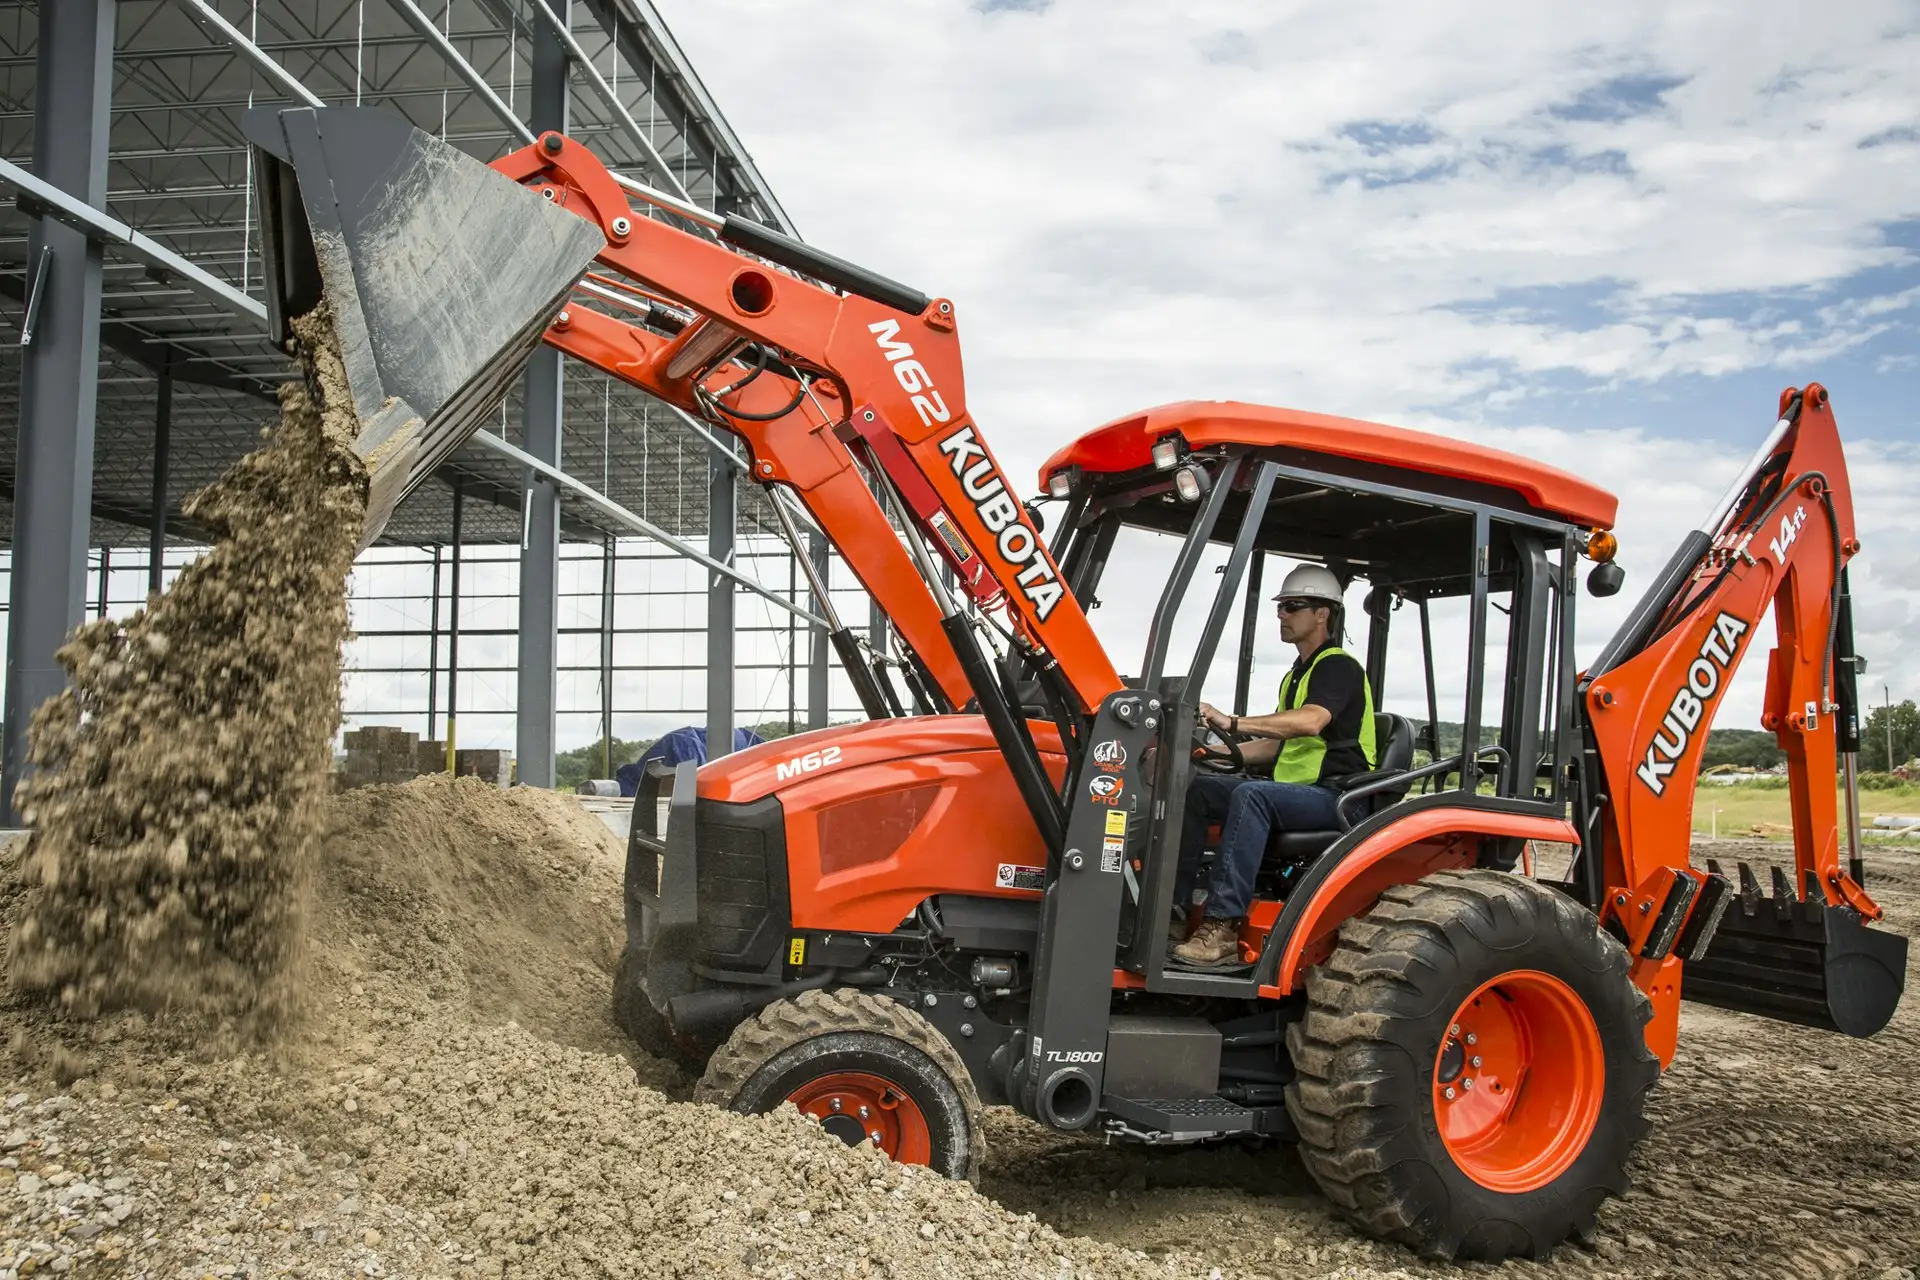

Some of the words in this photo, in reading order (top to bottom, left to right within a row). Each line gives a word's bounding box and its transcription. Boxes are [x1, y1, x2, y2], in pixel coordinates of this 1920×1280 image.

[868, 318, 951, 427] M62
[939, 425, 1066, 623] KUBOTA
[1635, 610, 1749, 798] KUBOTA
[776, 745, 843, 782] M62
[1091, 794, 1119, 806] PTO
[1046, 1050, 1103, 1063] TL1800
